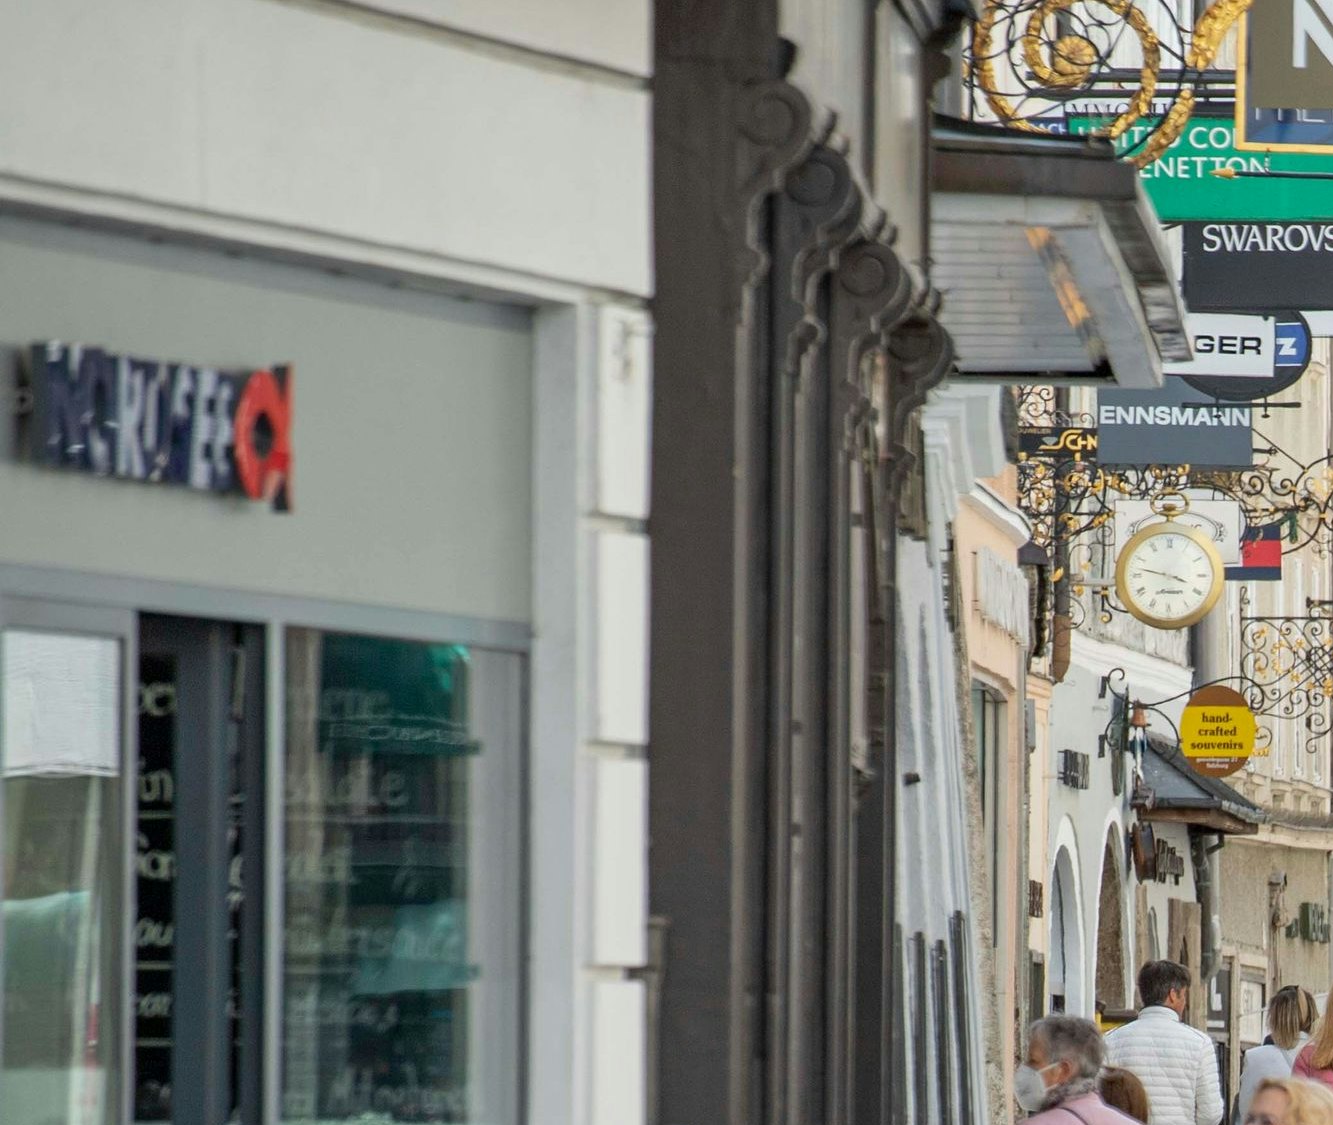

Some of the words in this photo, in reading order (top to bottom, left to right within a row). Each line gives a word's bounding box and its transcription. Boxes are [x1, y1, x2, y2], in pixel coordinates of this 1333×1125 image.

[1139, 155, 1268, 179] ENETTON
[1100, 404, 1250, 428] ENNSMANN
[1201, 711, 1233, 724] hand-
[1197, 725, 1238, 737] crafted
[1190, 739, 1244, 751] souvenirs
